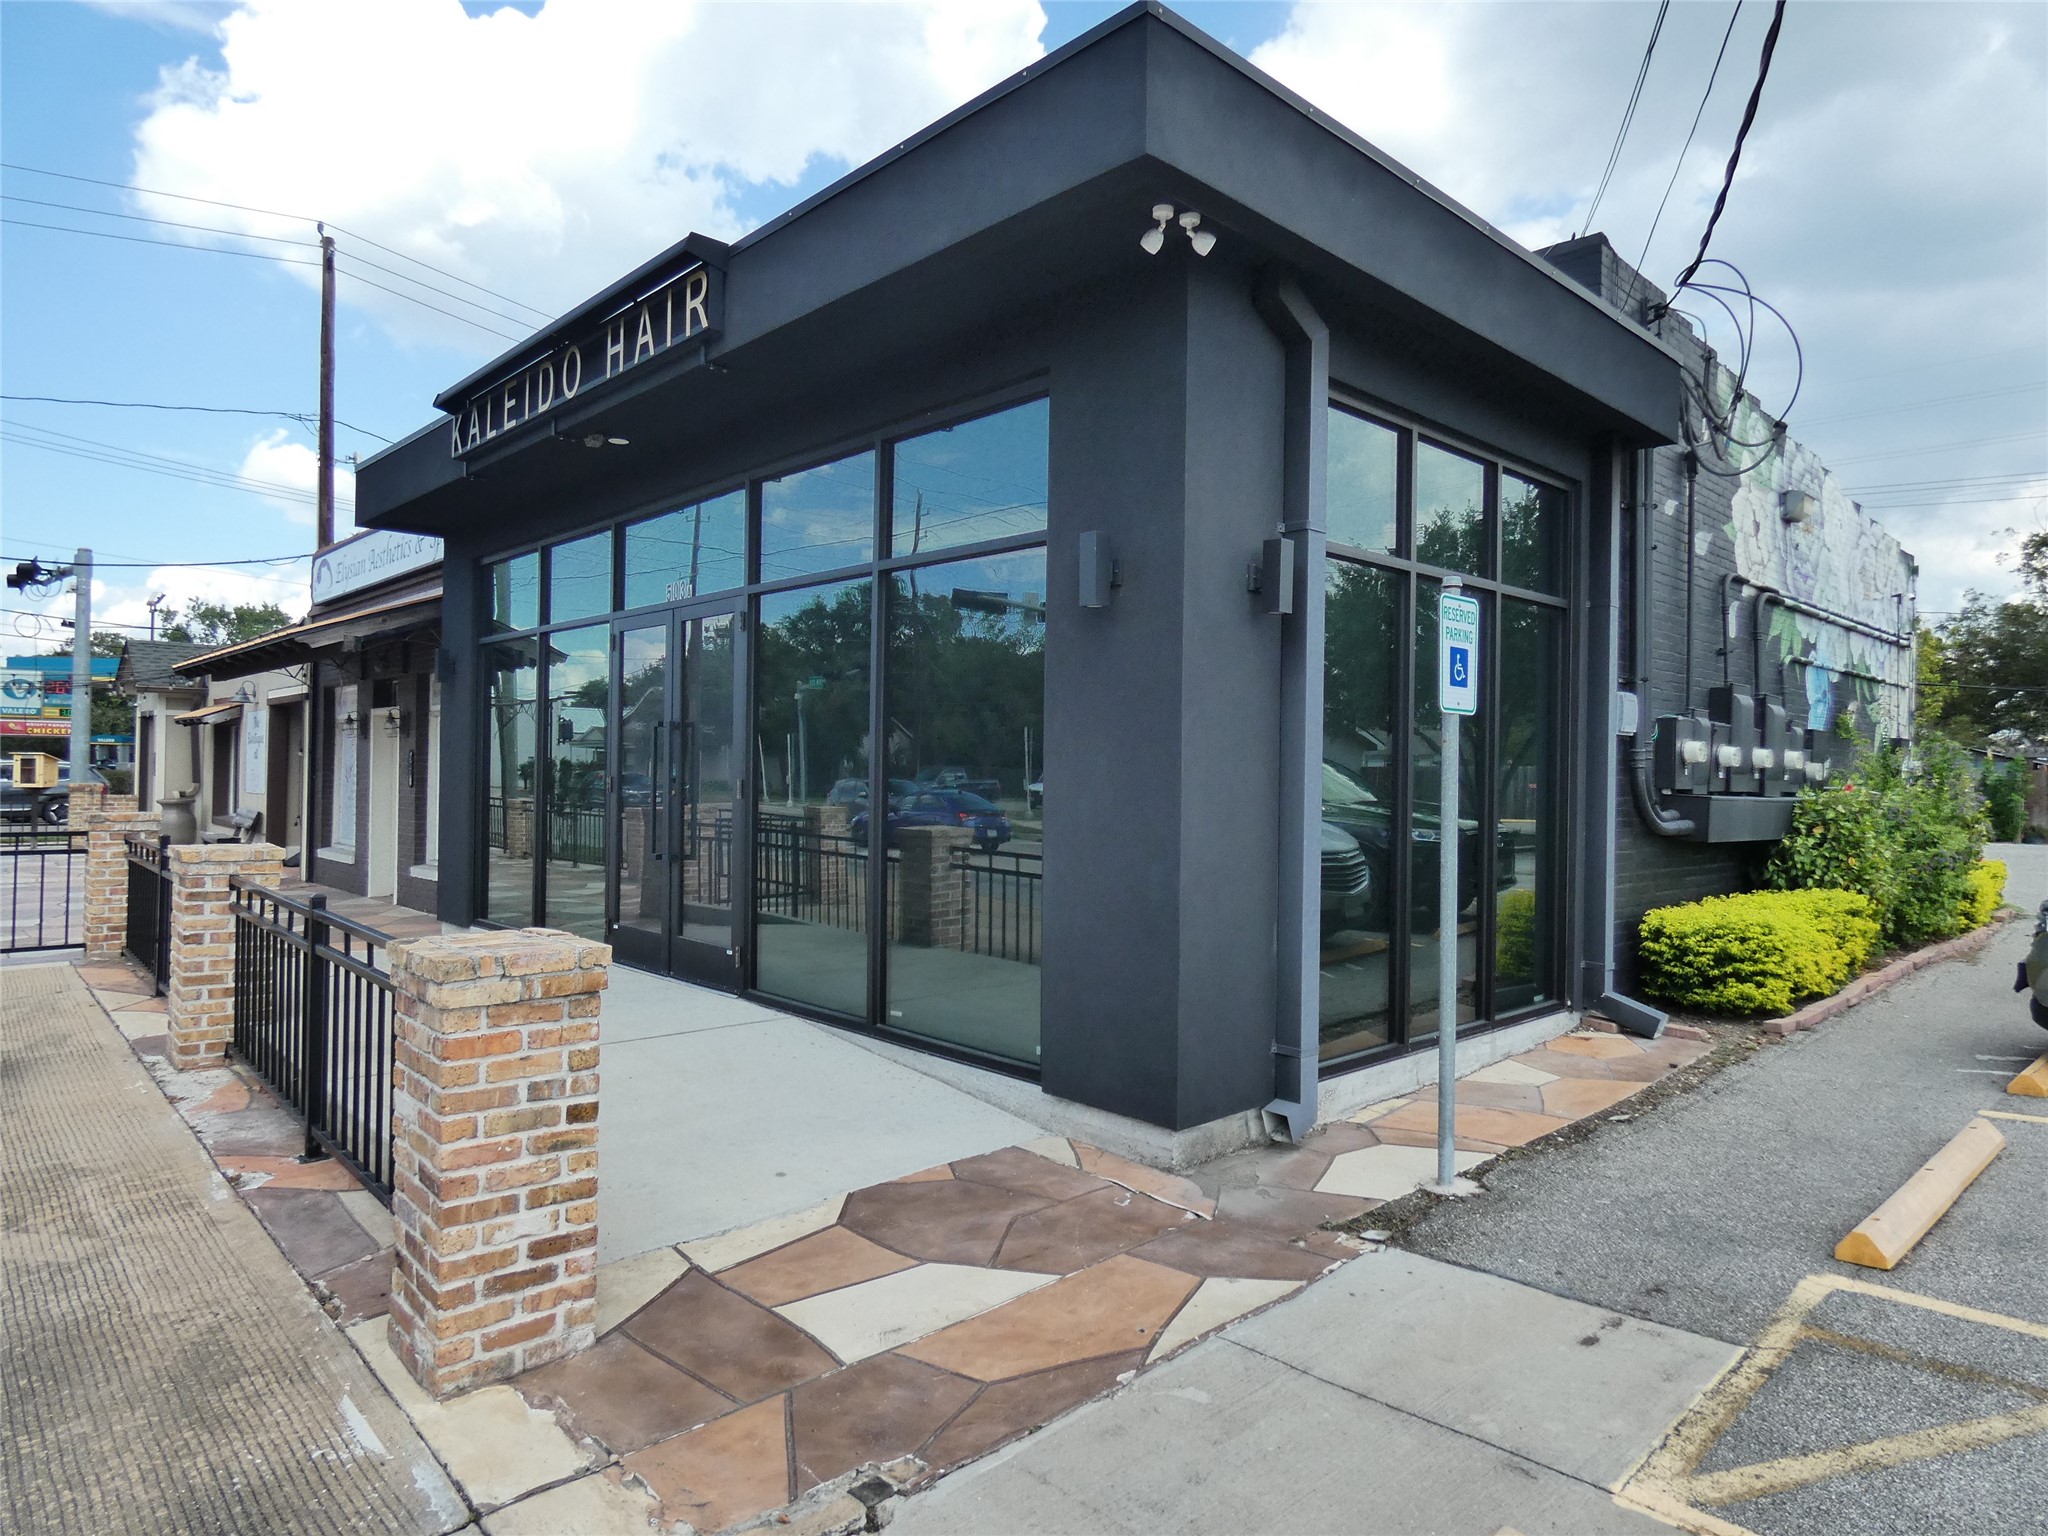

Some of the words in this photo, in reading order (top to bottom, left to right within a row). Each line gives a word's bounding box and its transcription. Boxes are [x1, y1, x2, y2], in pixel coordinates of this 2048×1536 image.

[451, 345, 582, 458] KALEIDO
[606, 269, 709, 379] HAIR
[335, 555, 367, 592] Elysian
[368, 535, 412, 572] Aesthetics
[415, 536, 425, 554] &
[1443, 606, 1476, 625] RESERVED
[1446, 627, 1474, 644] PARKING
